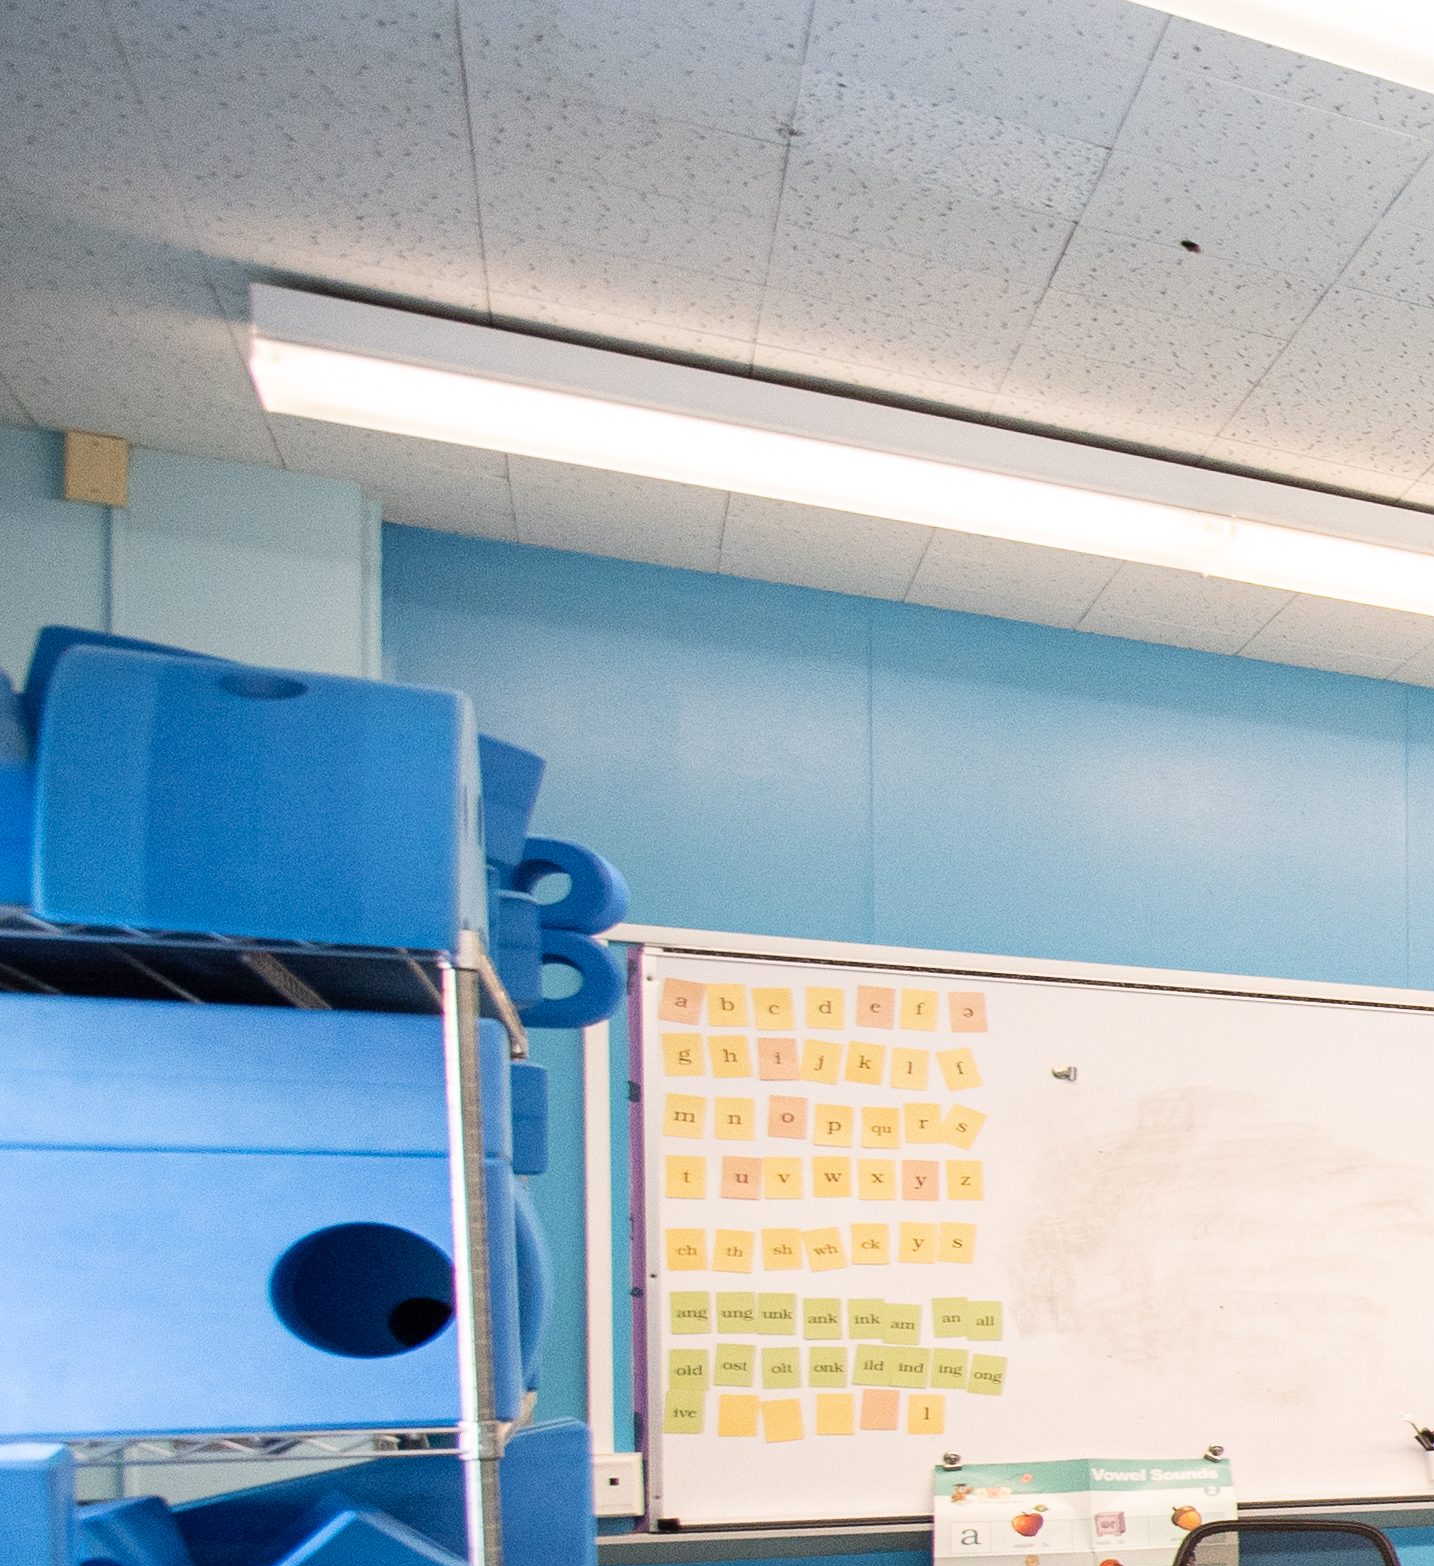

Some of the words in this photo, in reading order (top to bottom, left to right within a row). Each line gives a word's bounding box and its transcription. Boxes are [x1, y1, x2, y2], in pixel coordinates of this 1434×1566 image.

[675, 997, 687, 1008] a
[720, 997, 735, 1011] b
[768, 1004, 779, 1015] c
[818, 1001, 831, 1014] d
[870, 1003, 881, 1013] e
[917, 1002, 924, 1015] f
[678, 1049, 692, 1064] g
[723, 1049, 737, 1062] h
[774, 1052, 781, 1064] i
[814, 1056, 824, 1071] j
[859, 1055, 870, 1069] k
[908, 1061, 912, 1074] l
[674, 1111, 695, 1123] m
[728, 1115, 741, 1125] n
[781, 1113, 795, 1123] o
[828, 1121, 841, 1135] p
[871, 1125, 891, 1136] qu
[919, 1119, 928, 1129] r
[956, 1123, 966, 1132] s
[683, 1172, 689, 1183] t
[735, 1174, 748, 1183] u
[778, 1174, 789, 1183] v
[824, 1173, 841, 1182] w
[871, 1174, 883, 1183] x
[915, 1176, 926, 1189] y
[961, 1176, 970, 1186] z
[676, 1245, 697, 1256] ch
[727, 1246, 743, 1257] th
[773, 1244, 792, 1255] sh
[814, 1244, 838, 1255] wh
[861, 1239, 880, 1249] ck
[913, 1239, 924, 1252] y
[953, 1239, 962, 1248] s
[677, 1310, 707, 1320] ang
[722, 1310, 753, 1320] ung
[762, 1309, 792, 1319] unk
[808, 1313, 837, 1324] ank
[855, 1314, 880, 1324] ink
[890, 1321, 915, 1330] am
[942, 1315, 961, 1323] an
[976, 1316, 994, 1326] all
[675, 1365, 702, 1376] old
[722, 1362, 746, 1371] ost
[771, 1363, 792, 1374] olt
[814, 1362, 843, 1372] onk
[864, 1360, 884, 1371] ild
[899, 1363, 924, 1373] ind
[939, 1365, 962, 1376] ing
[974, 1372, 1002, 1383] ong
[674, 1409, 696, 1418] ive
[1091, 1469, 1147, 1482] Vowel
[1150, 1468, 1219, 1481] Sounds
[960, 1528, 982, 1546] a
